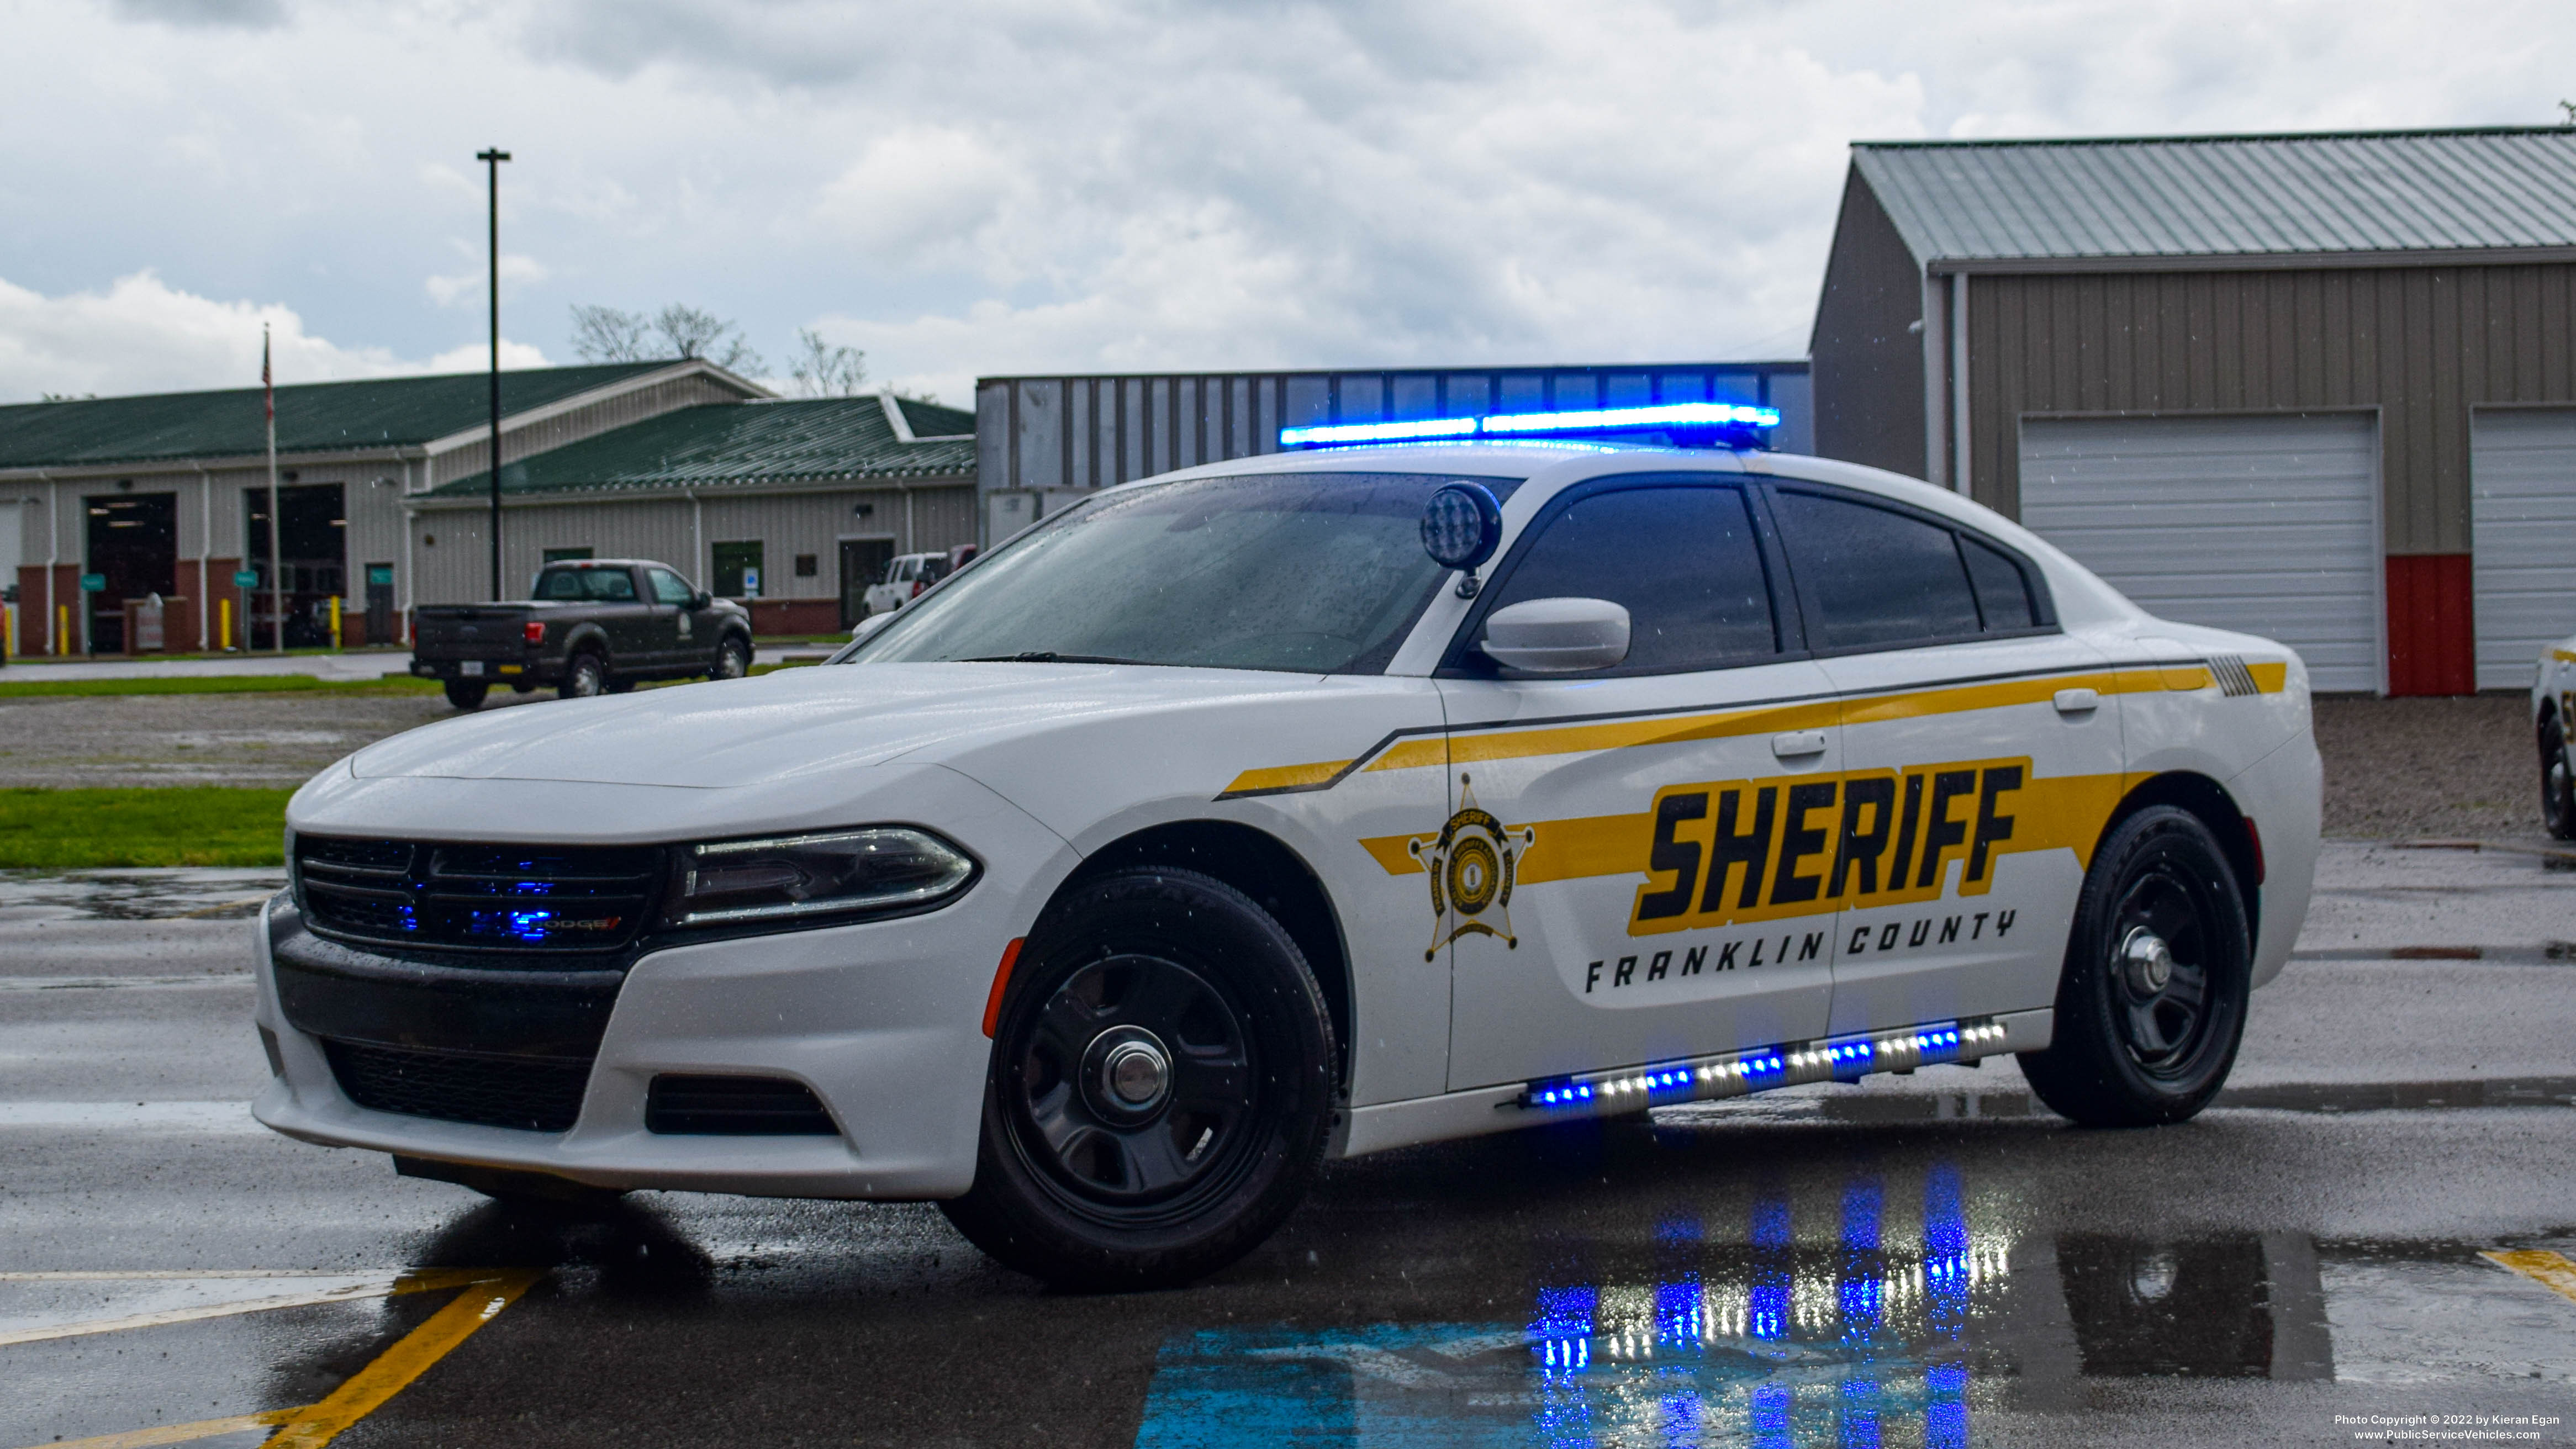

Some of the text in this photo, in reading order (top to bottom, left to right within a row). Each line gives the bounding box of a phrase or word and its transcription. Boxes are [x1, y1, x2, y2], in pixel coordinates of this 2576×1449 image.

[1450, 811, 1491, 829] SHERIFF
[1637, 765, 2024, 921] SHERIFF
[1501, 855, 1512, 900] COUNTY
[531, 919, 608, 928] DODGE
[1586, 909, 2017, 993] FRANKLIN COUNTY
